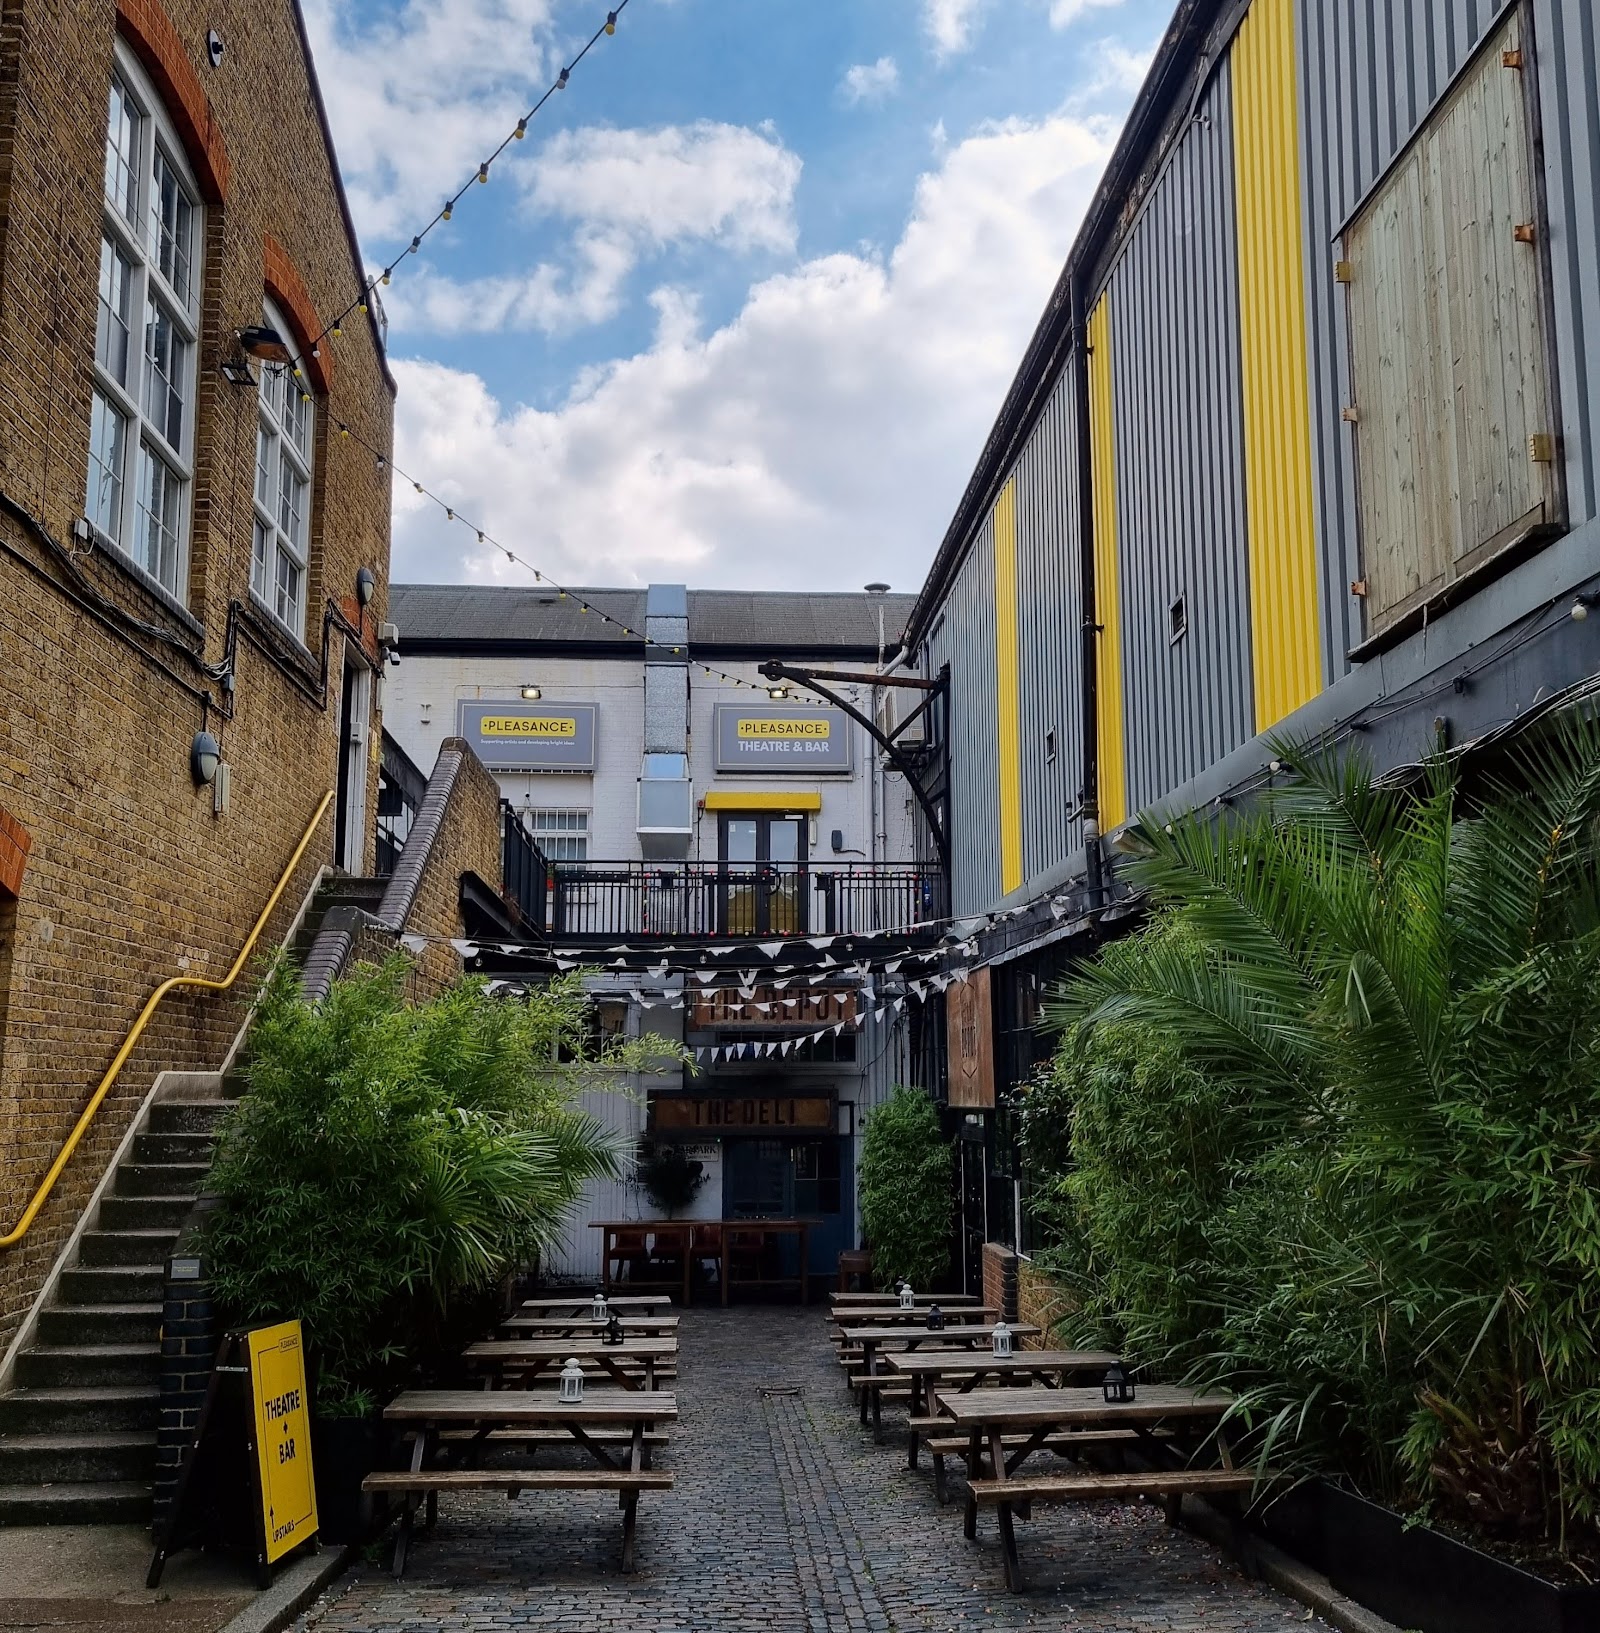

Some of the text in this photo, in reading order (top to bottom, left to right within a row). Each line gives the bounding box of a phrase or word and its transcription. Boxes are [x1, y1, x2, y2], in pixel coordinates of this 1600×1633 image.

[488, 720, 568, 732] PLEASANCE
[745, 723, 823, 734] PLEASANCE
[738, 740, 830, 752] THEATRE & BAR
[692, 1099, 796, 1124] THE DELI
[265, 1388, 301, 1422] THEATRE
[279, 1438, 296, 1465] BAR
[272, 1519, 295, 1543] UPSTAIRS
